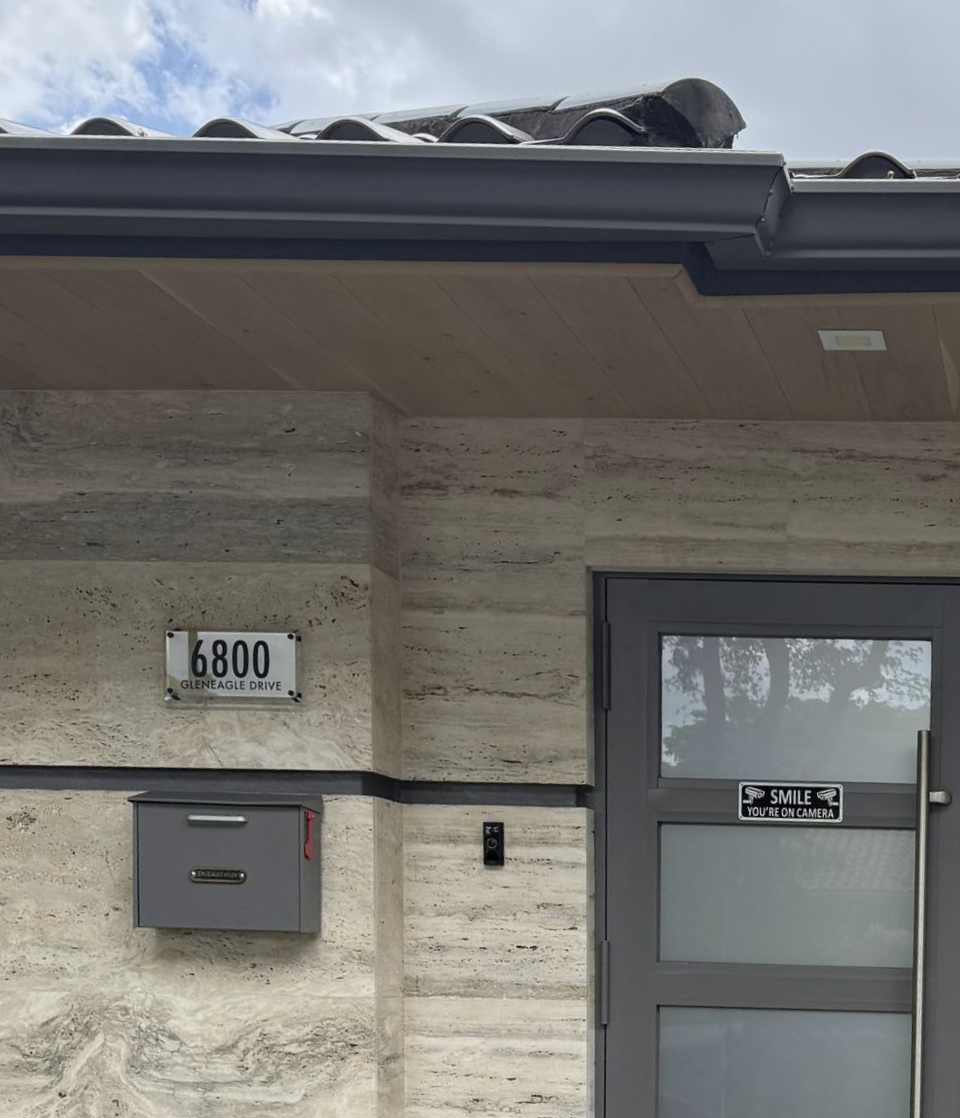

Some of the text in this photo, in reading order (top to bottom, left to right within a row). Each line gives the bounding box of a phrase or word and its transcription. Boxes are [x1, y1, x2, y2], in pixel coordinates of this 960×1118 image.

[191, 639, 270, 678] 6800
[180, 679, 282, 691] GLENEAGLE DRIVE
[770, 789, 812, 805] SMILE
[747, 806, 835, 819] YOU'RE ON CAMERA
